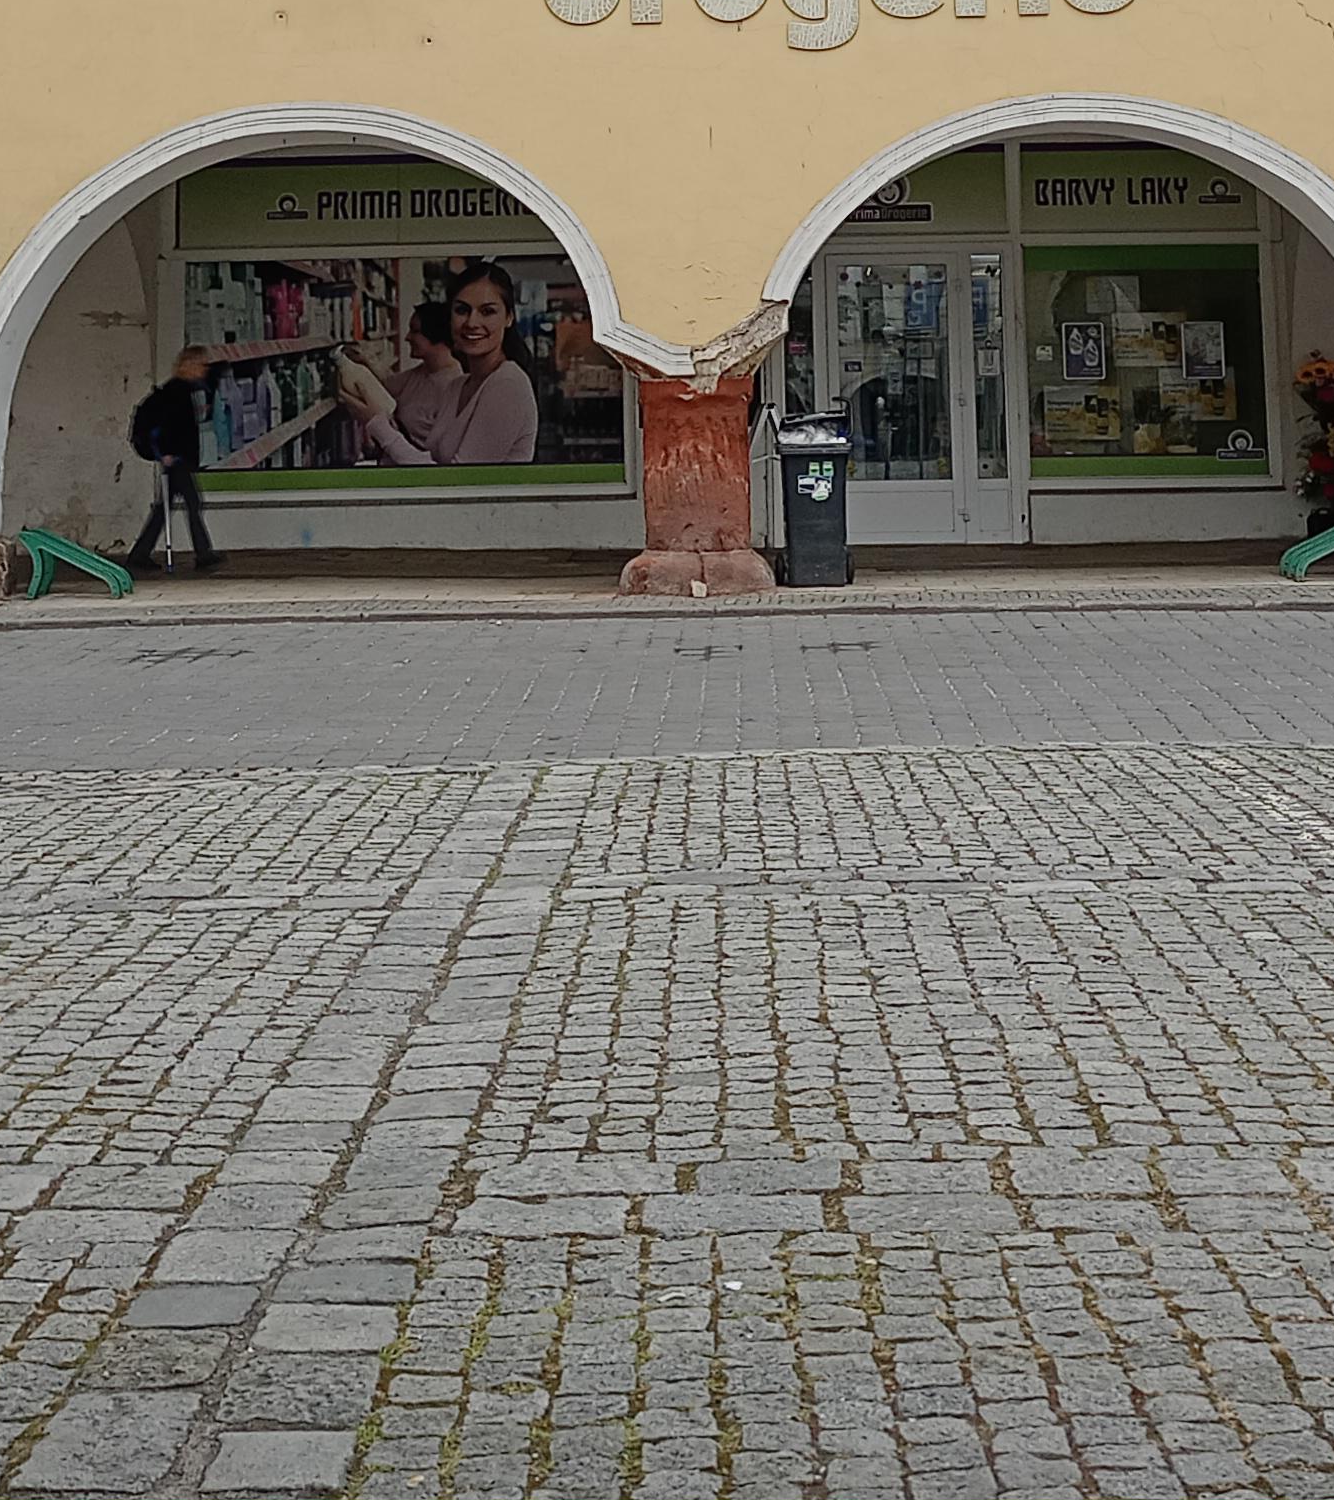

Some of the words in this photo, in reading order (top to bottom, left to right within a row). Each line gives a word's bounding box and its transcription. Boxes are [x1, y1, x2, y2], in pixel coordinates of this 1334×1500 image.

[318, 190, 401, 220] PRIMA
[1035, 178, 1114, 206] BARVY
[1127, 177, 1188, 204] LAKY
